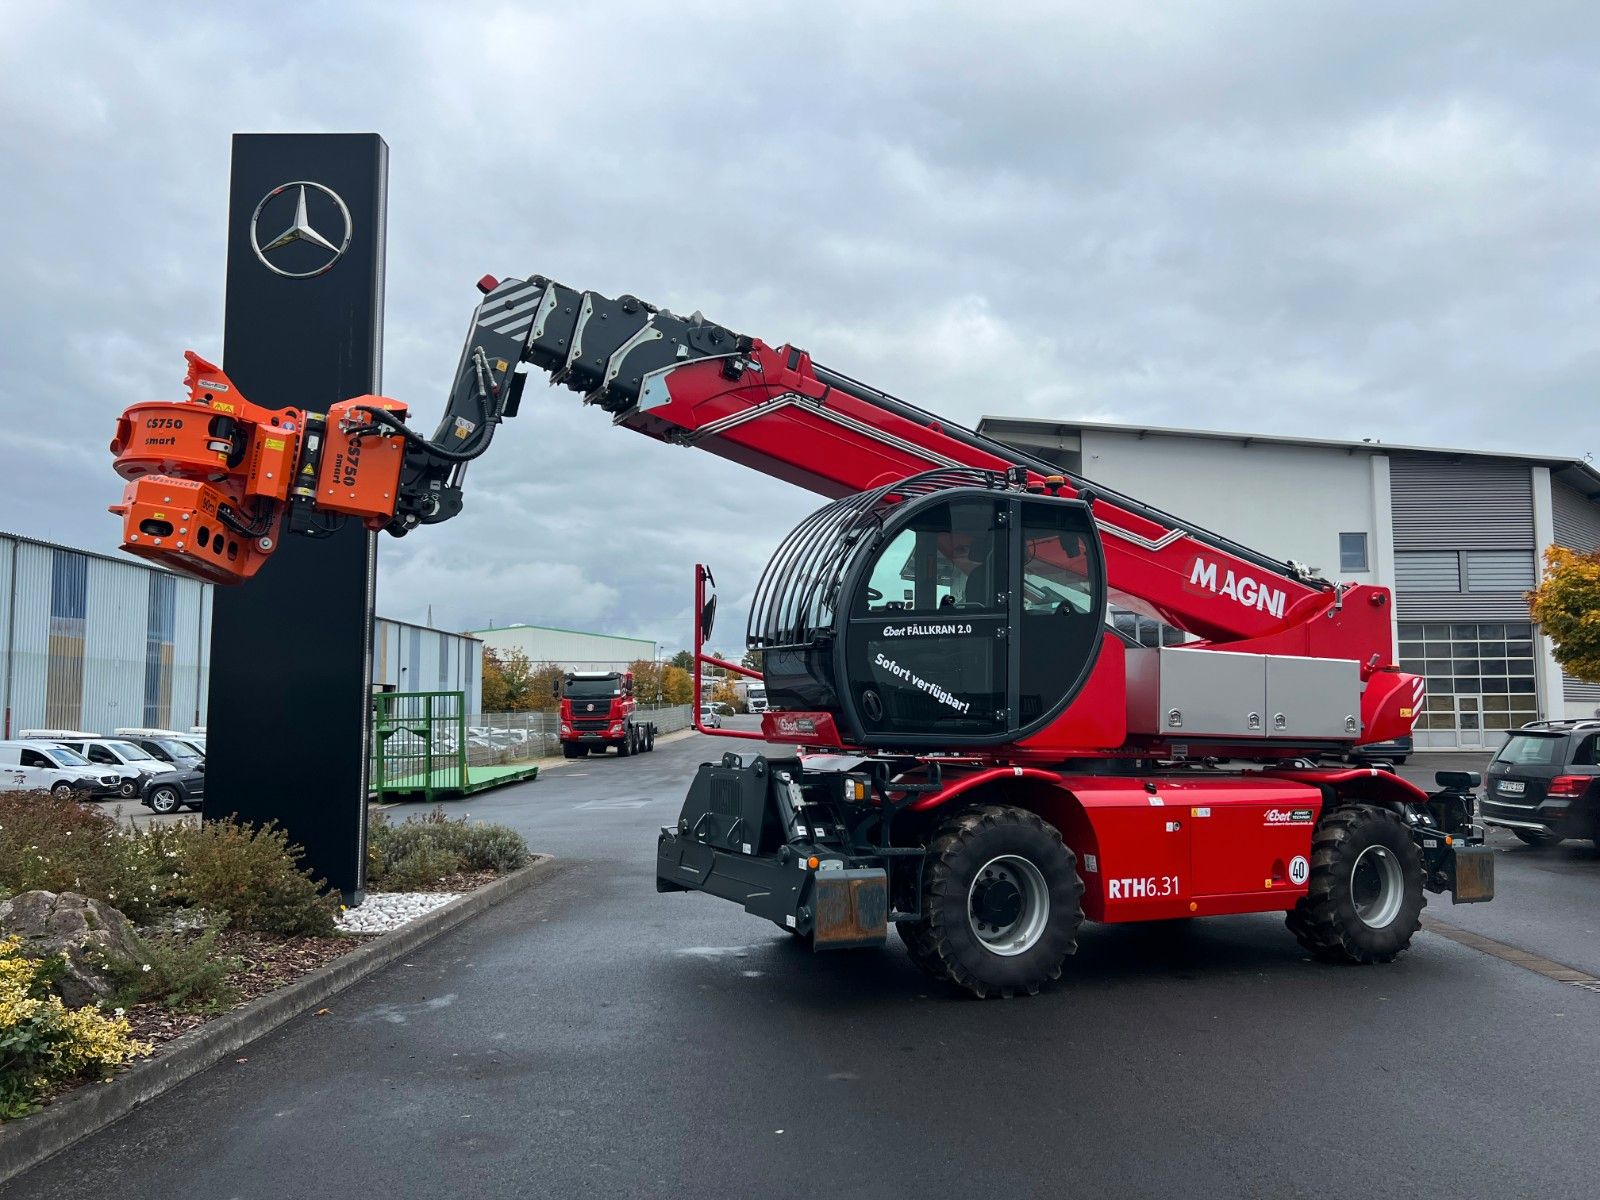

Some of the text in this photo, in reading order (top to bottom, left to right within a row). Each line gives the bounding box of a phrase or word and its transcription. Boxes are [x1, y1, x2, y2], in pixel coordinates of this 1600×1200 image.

[146, 418, 183, 430] CS750
[144, 436, 176, 445] smart
[333, 453, 344, 484] smart
[343, 437, 362, 487] CS750
[1189, 557, 1287, 620] MAGNI
[883, 624, 972, 637] Ebert FÄLLKRAN 2.0
[874, 653, 971, 715] Sofort verfügbar!
[1267, 809, 1291, 821] Ebert
[1292, 861, 1305, 879] 40
[1108, 875, 1180, 899] RTH6.31
